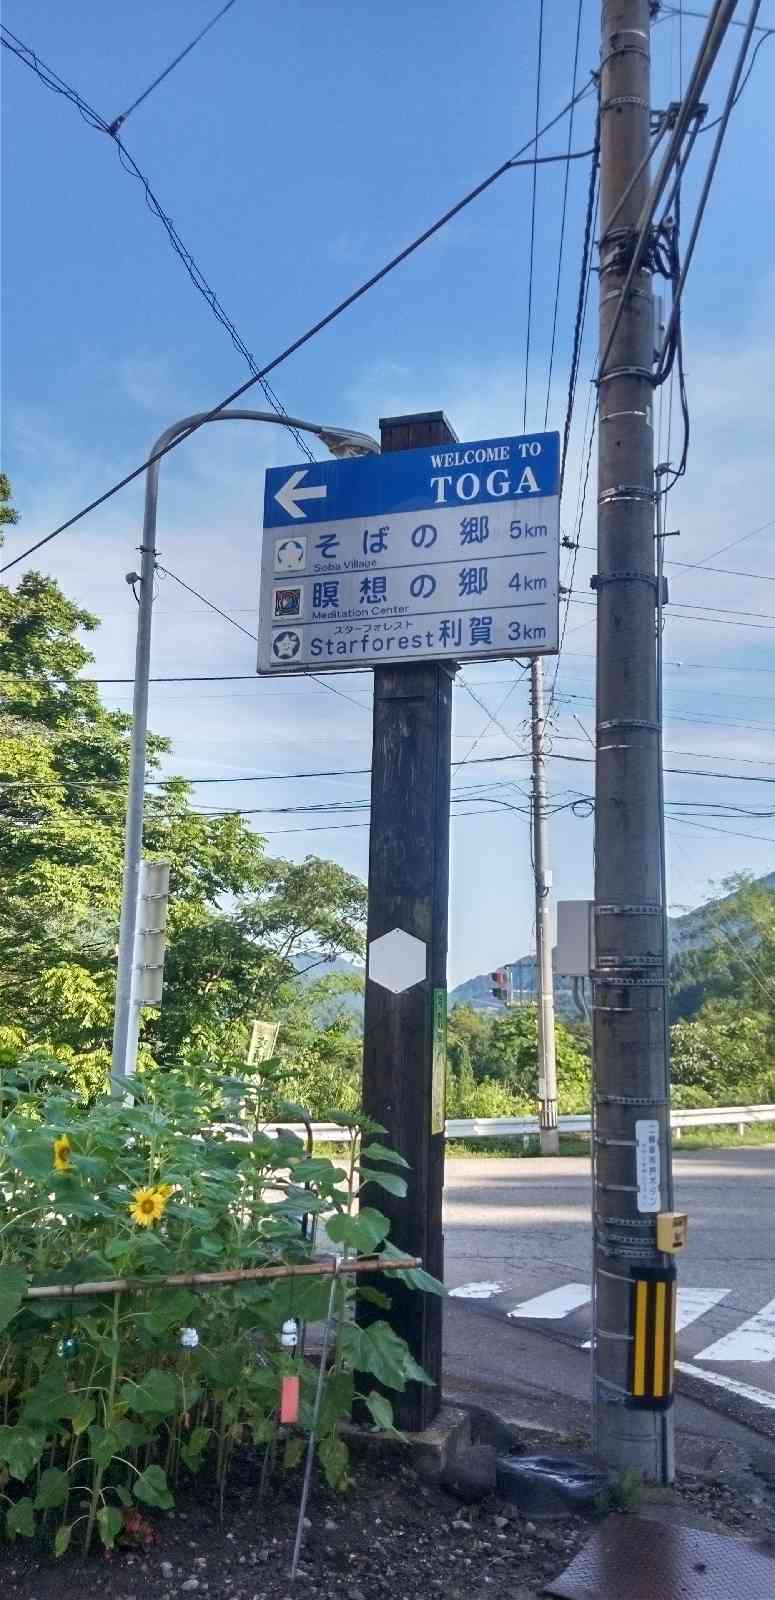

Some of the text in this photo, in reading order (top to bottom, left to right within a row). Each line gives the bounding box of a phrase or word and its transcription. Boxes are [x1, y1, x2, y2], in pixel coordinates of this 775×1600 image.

[430, 441, 542, 469] WELCOME TO
[430, 466, 541, 503] TOGA
[314, 515, 548, 559] そばの郷 5km
[313, 562, 341, 573] Soba
[312, 566, 547, 609] 瞑想の郷 4km
[312, 605, 410, 620] Meditation Center
[508, 621, 547, 641] 3km
